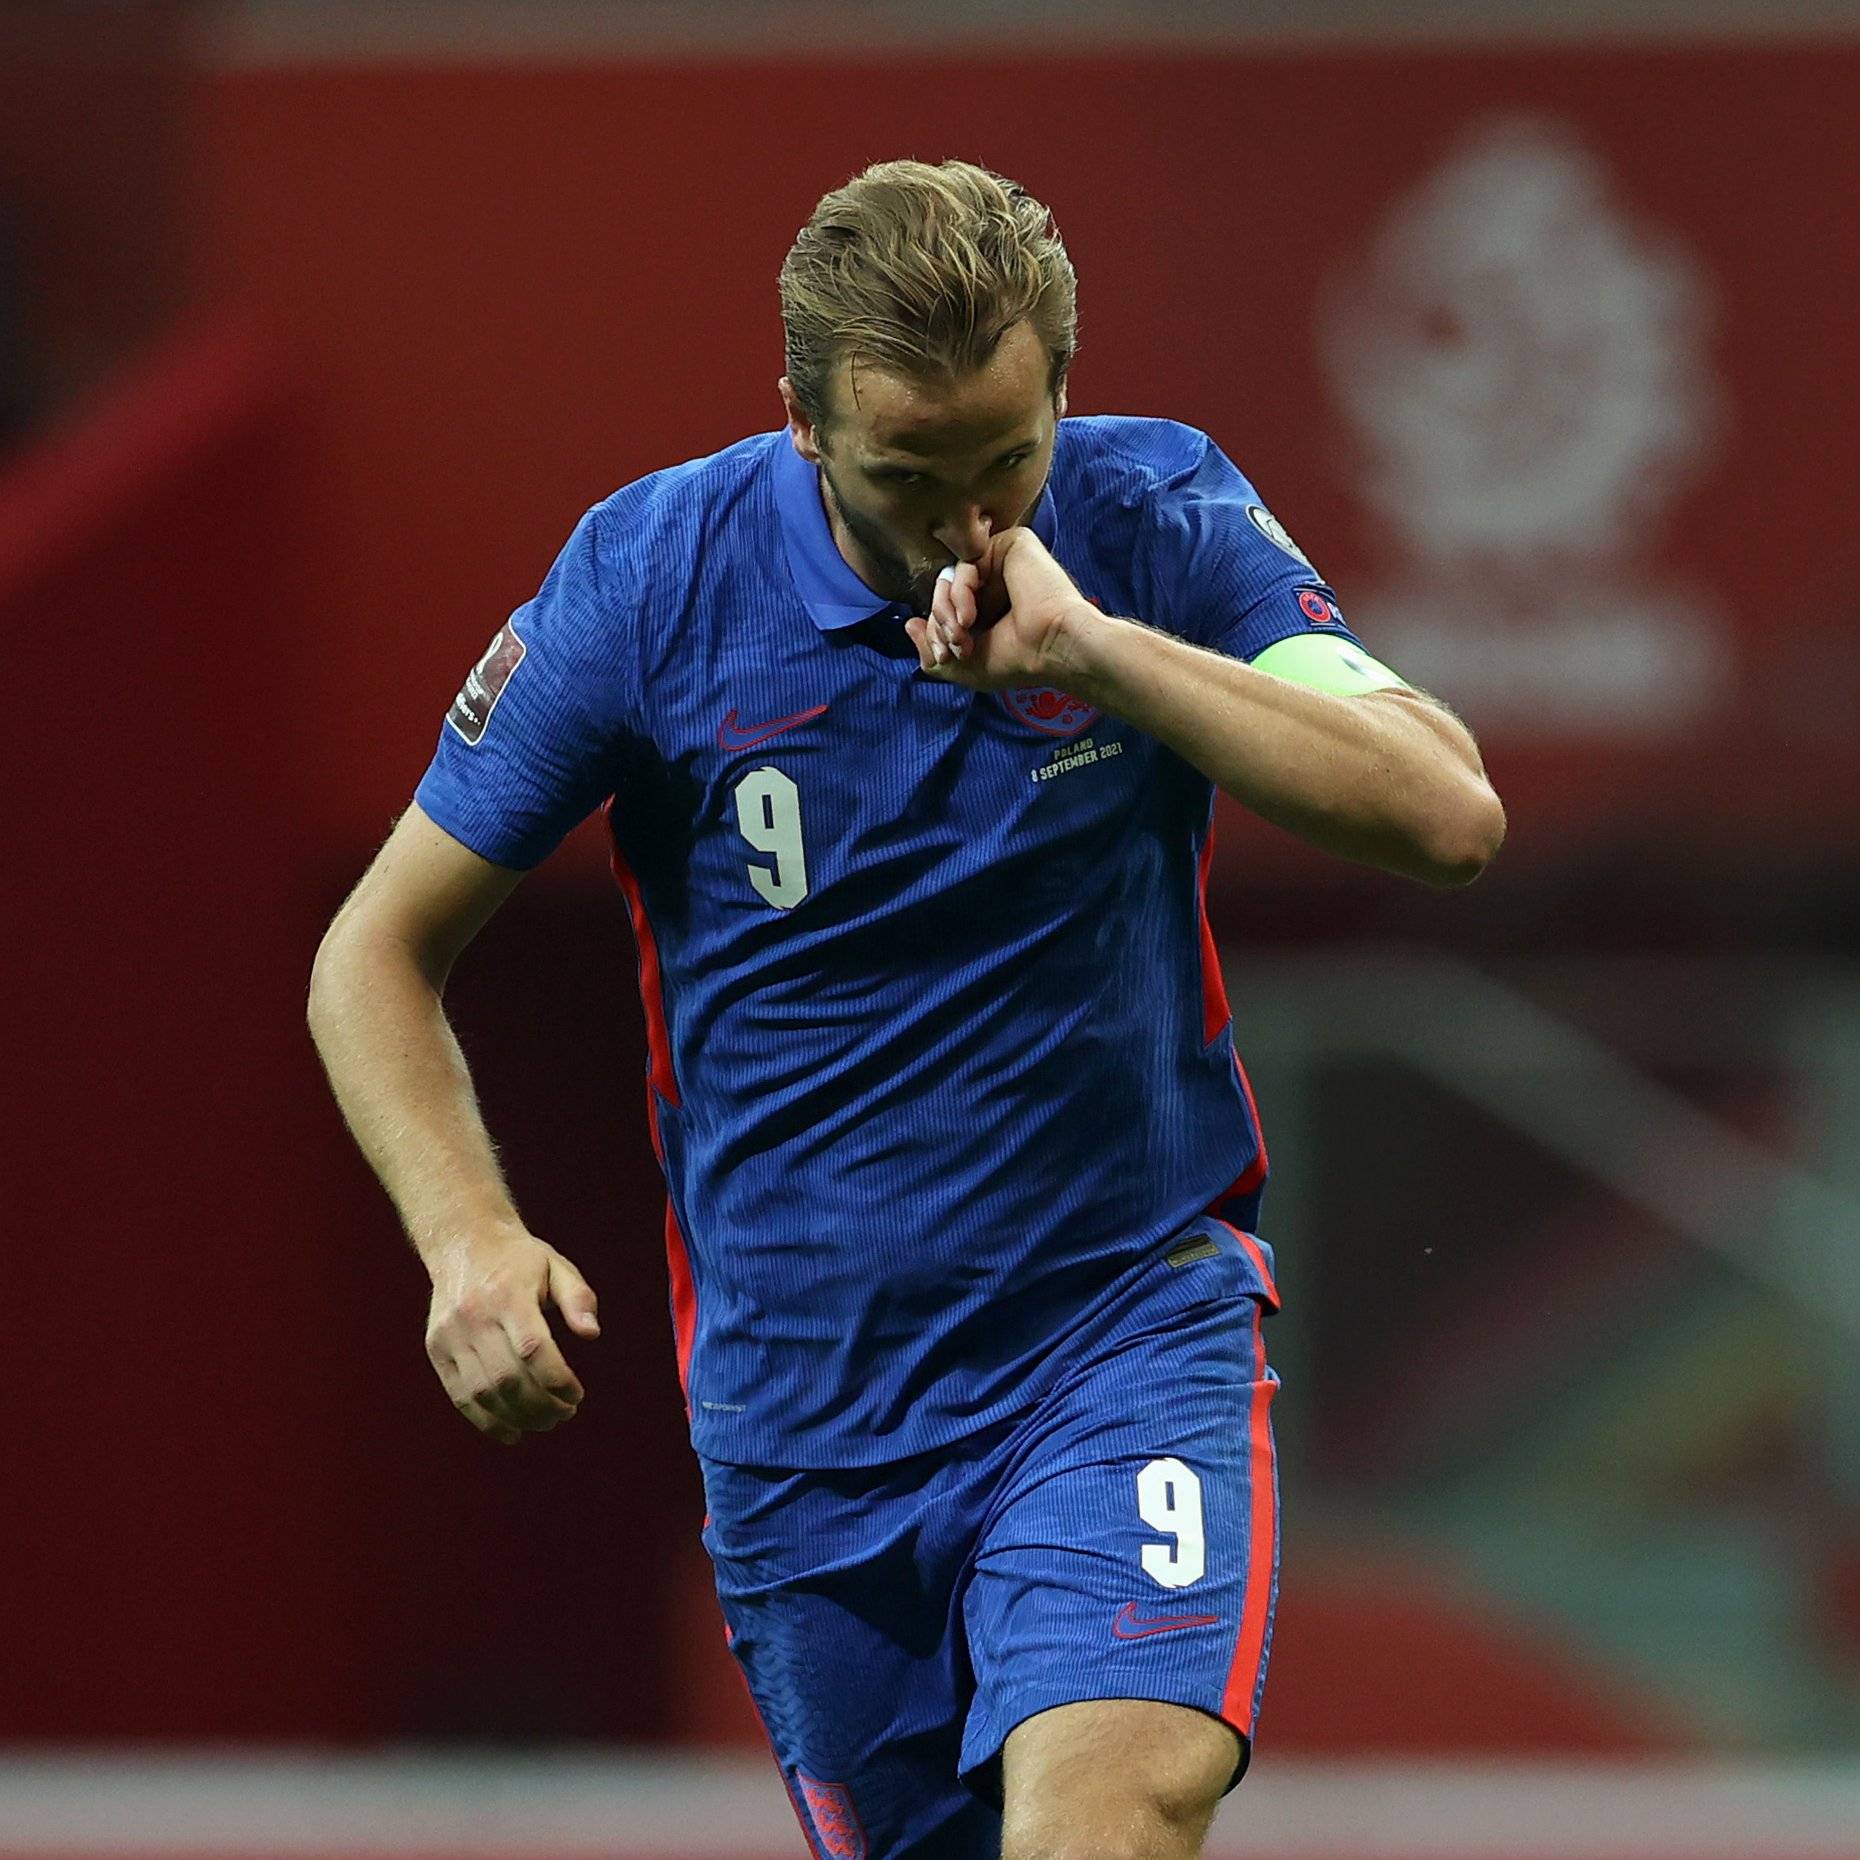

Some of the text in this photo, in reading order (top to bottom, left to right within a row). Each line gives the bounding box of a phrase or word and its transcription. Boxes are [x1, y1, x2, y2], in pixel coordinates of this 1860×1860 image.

[1031, 742, 1123, 782] 8 SEPTEMBER 2021
[1054, 738, 1094, 760] POLAND
[735, 766, 808, 911] 9
[1137, 1457, 1205, 1588] 9
